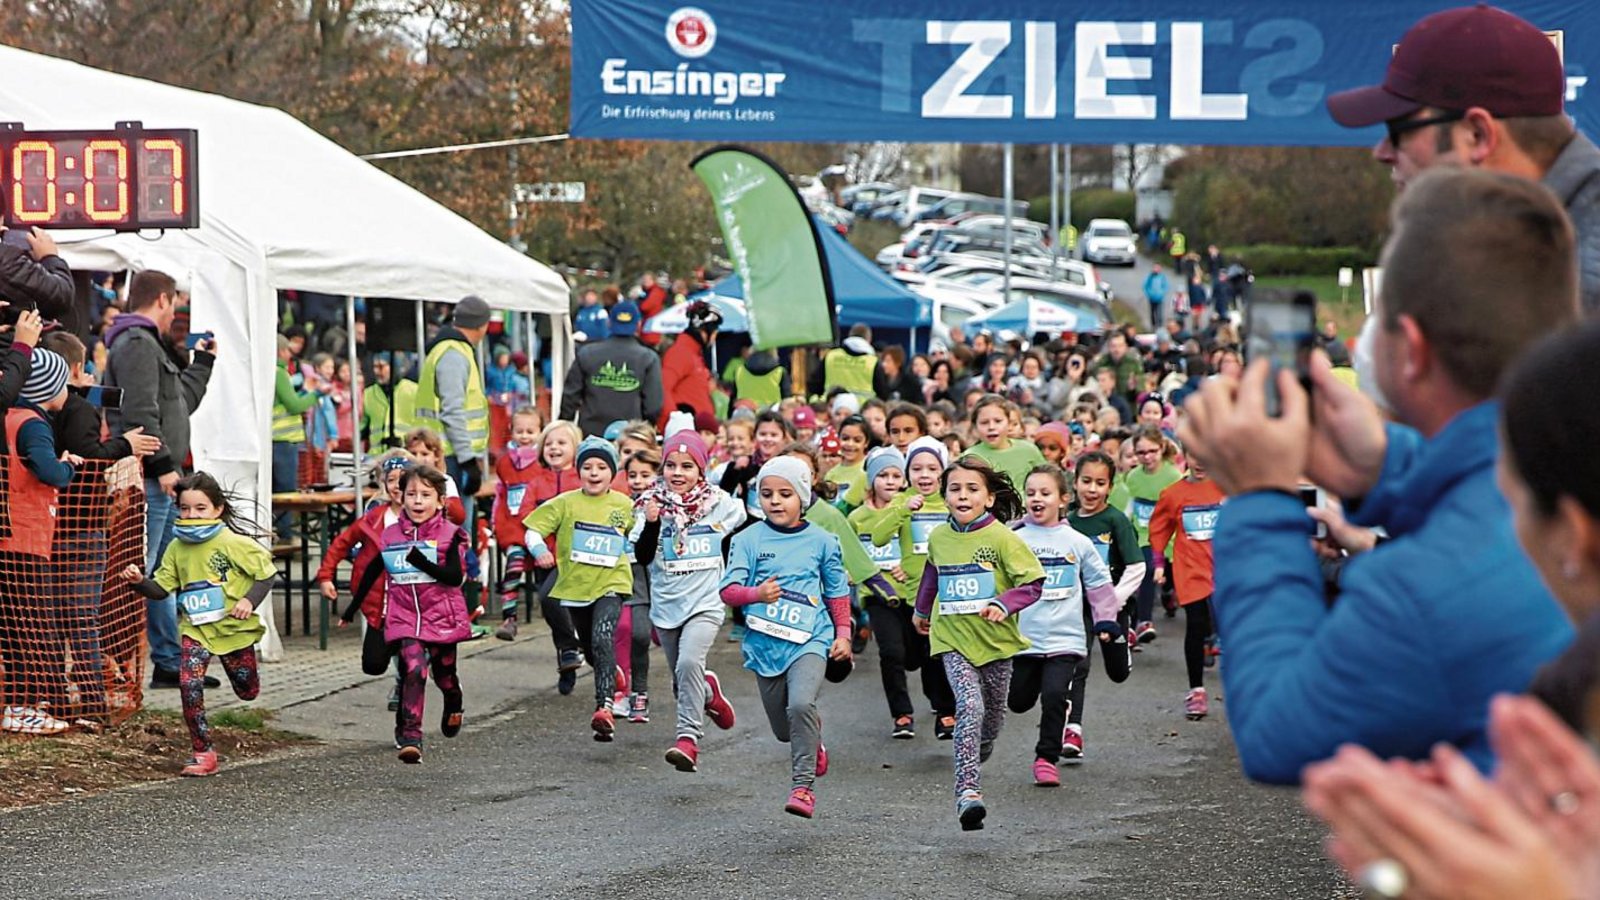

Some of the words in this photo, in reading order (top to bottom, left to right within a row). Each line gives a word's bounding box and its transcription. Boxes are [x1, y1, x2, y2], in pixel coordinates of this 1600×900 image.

[921, 20, 1248, 120] ZIEL
[600, 58, 786, 105] Ensinger
[602, 105, 620, 119] Die
[624, 105, 690, 122] Erfrischung
[694, 107, 732, 120] deines
[735, 108, 775, 121] Lebens
[13, 139, 183, 222] 0:07
[584, 535, 611, 552] 471
[684, 537, 711, 555] 06
[946, 578, 979, 597] 469
[766, 600, 802, 624] 616
[950, 602, 976, 612] Victoria
[765, 624, 791, 638] Sophia
